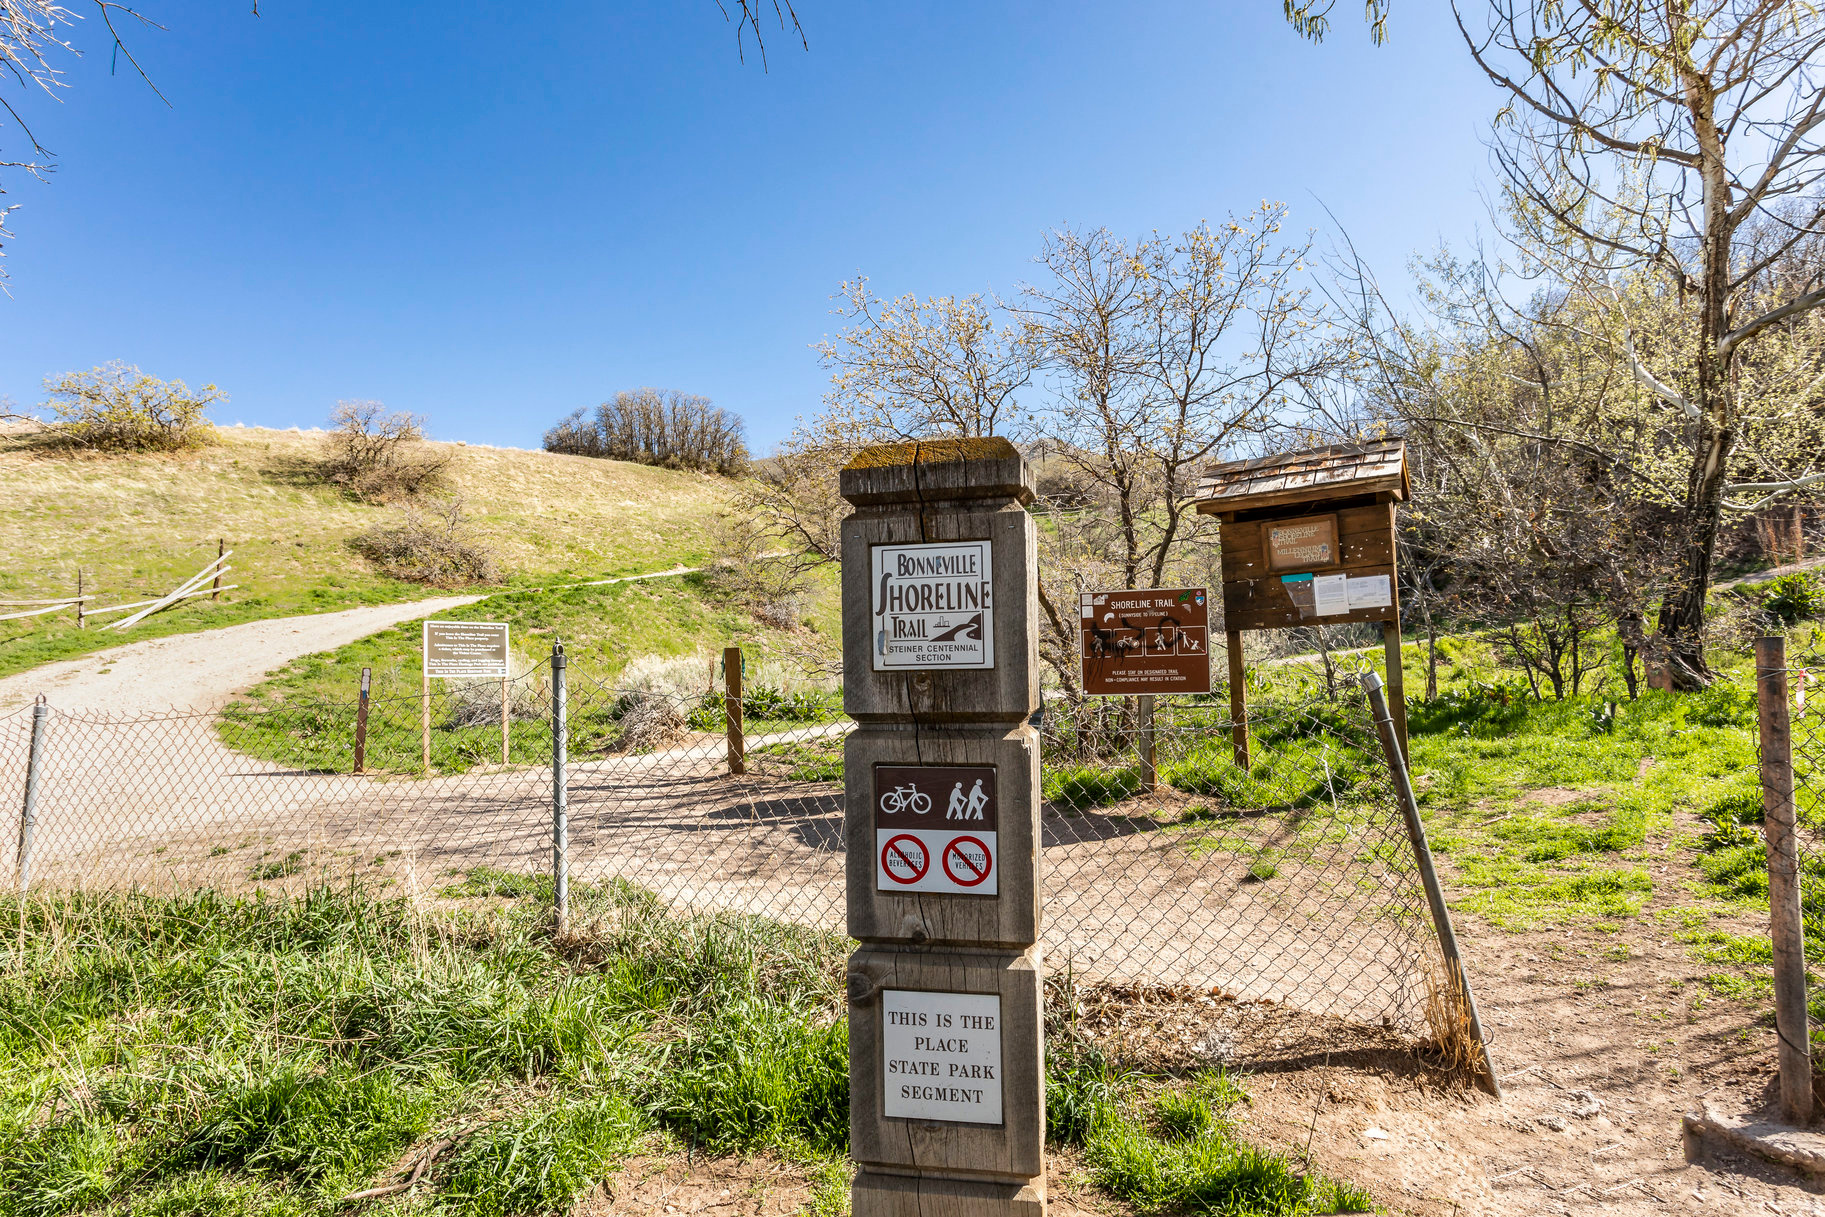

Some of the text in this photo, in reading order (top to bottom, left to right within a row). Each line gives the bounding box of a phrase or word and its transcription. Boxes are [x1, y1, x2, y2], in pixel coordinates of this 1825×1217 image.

[897, 553, 977, 577] BONNEVILLE
[875, 572, 991, 616] SHORELINE
[1111, 599, 1176, 609] SHORELINE TRAIL
[890, 615, 929, 639] TRAIL
[888, 644, 979, 653] STEINER CENTENNIAL
[888, 1011, 995, 1030] THIS IS THE
[915, 1036, 968, 1053] PLACE
[889, 1060, 995, 1079] STATE PARK
[901, 1085, 984, 1103] SEGMENT
